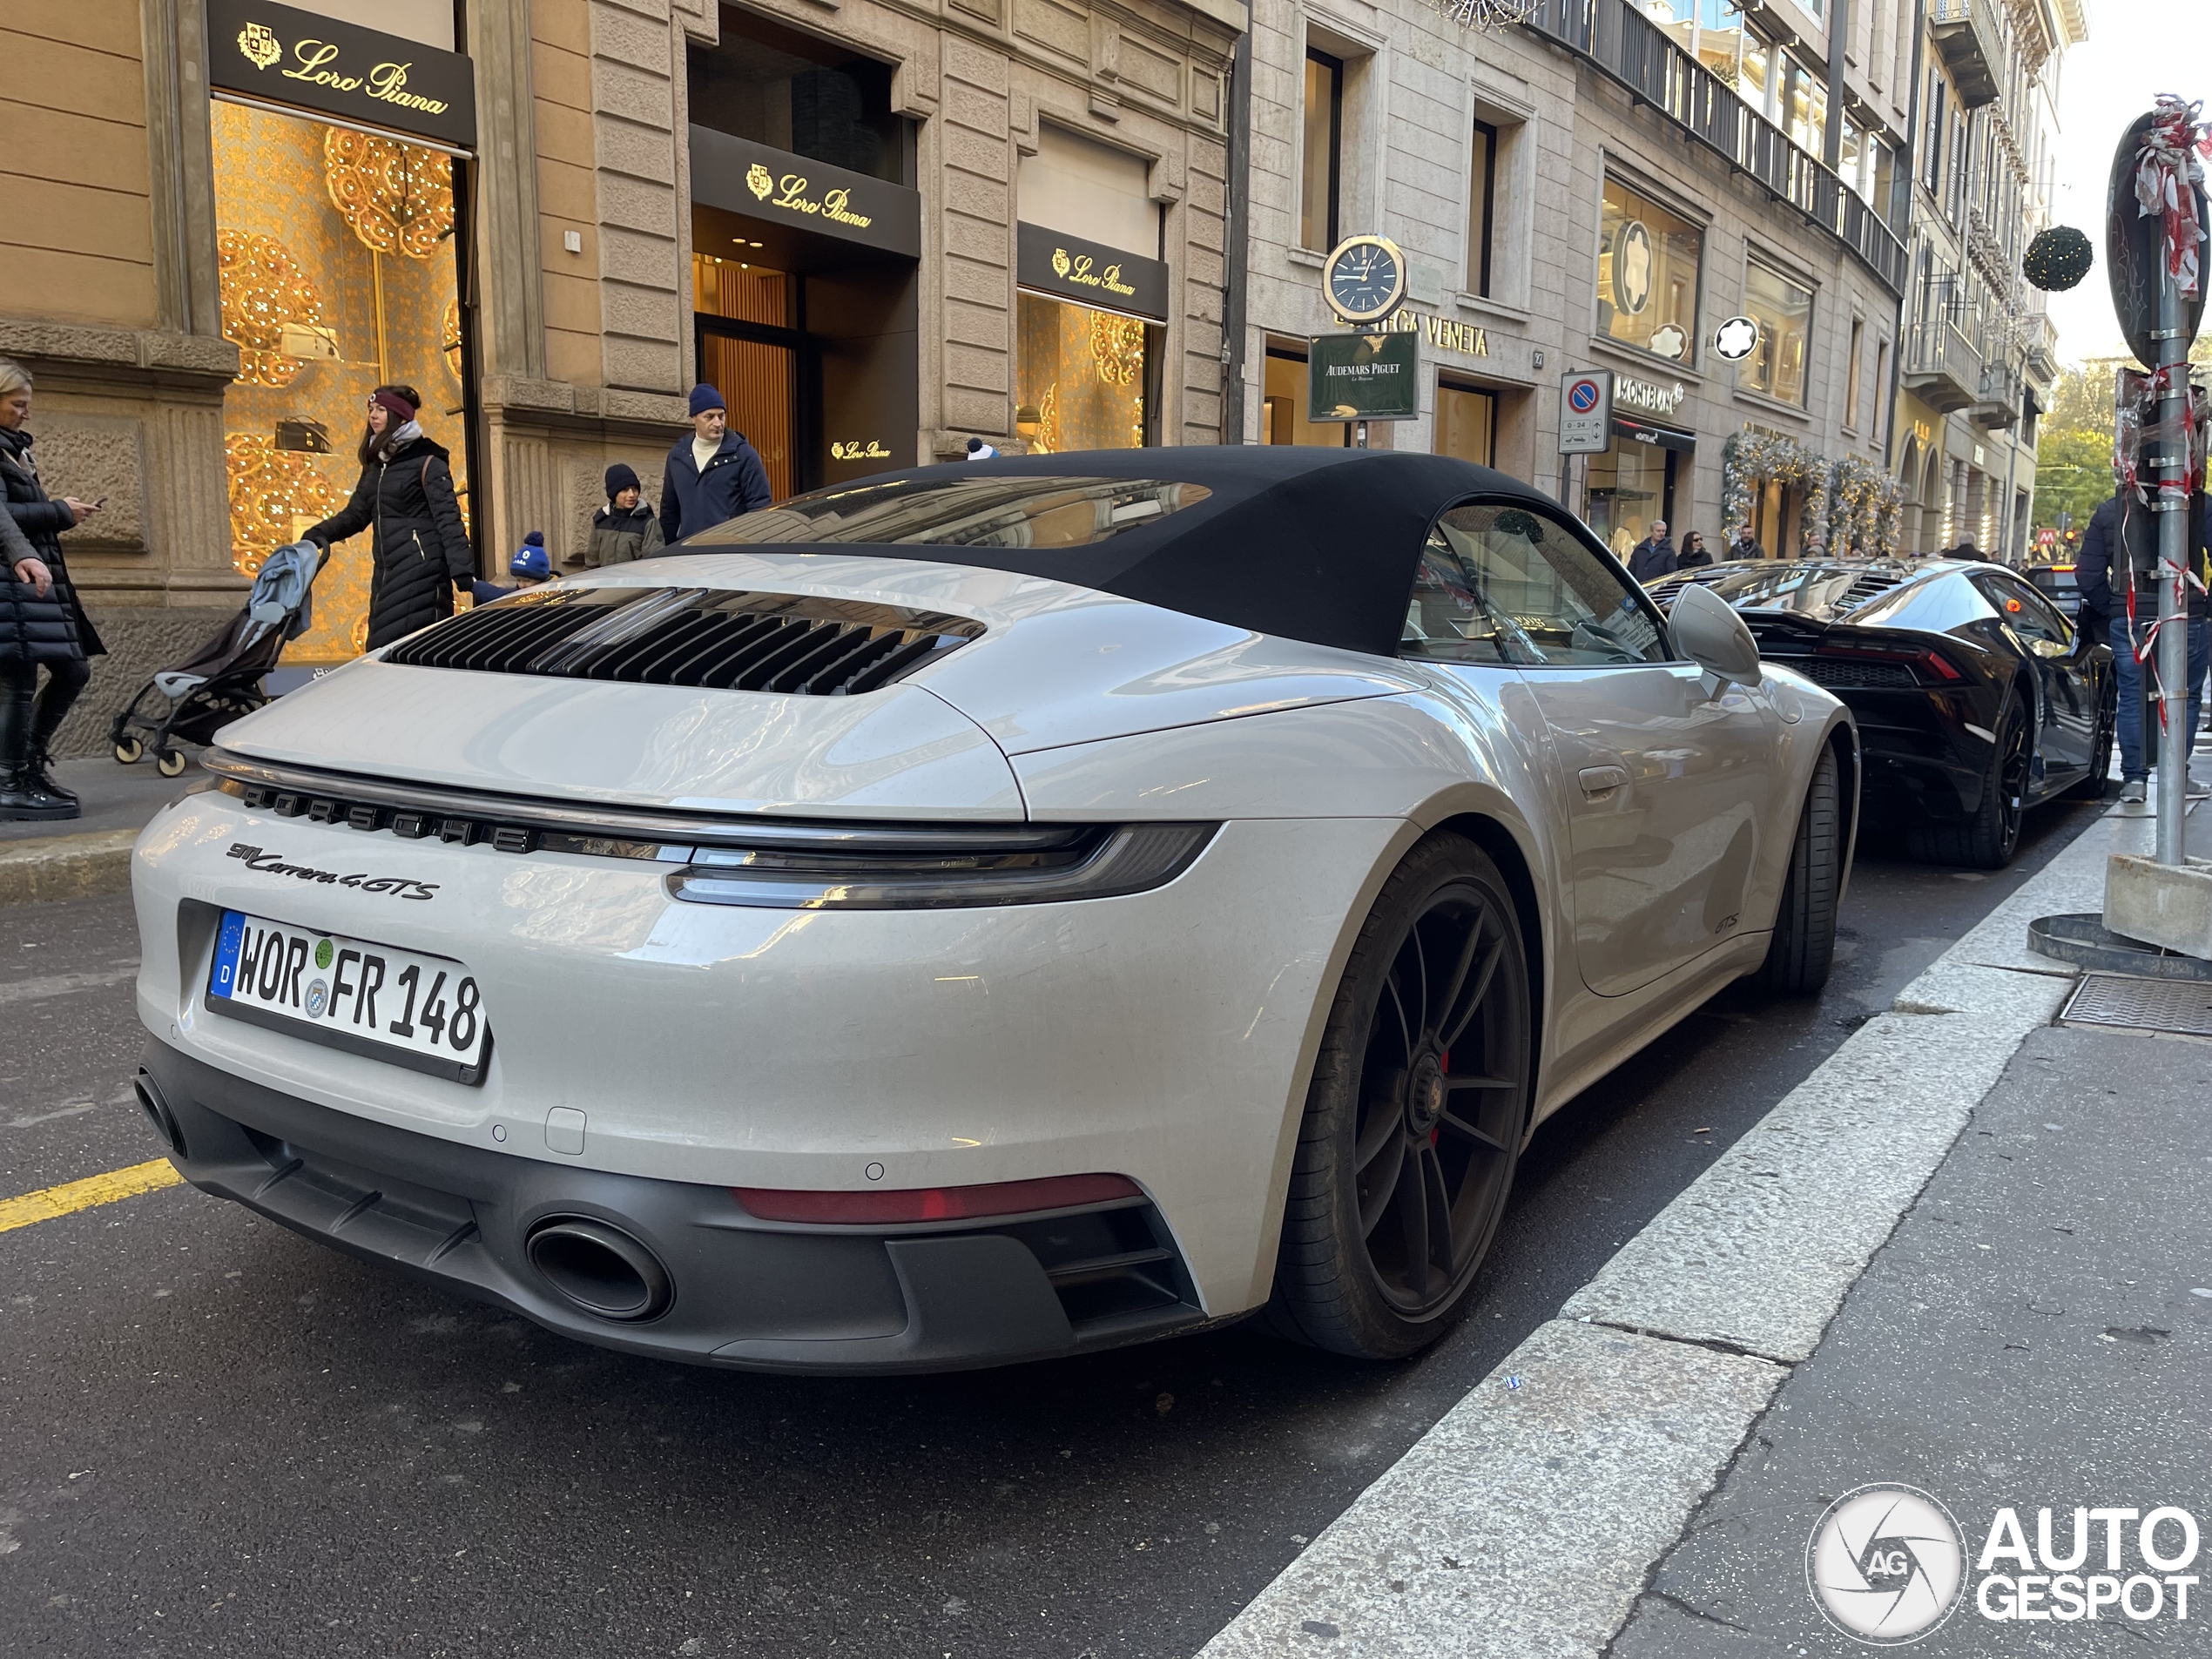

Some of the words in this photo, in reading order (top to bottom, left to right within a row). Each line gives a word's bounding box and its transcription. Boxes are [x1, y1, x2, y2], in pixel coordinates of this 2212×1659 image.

[282, 39, 363, 91] Loro
[365, 62, 448, 115] Piana
[772, 174, 821, 214] Loro
[821, 188, 872, 228] Piana
[1069, 255, 1102, 287] Loro
[1101, 264, 1136, 295] Piana
[1426, 315, 1489, 356] VENETA
[1325, 364, 1370, 376] AUDEMARS
[1372, 362, 1400, 374] PIGUET
[1616, 375, 1676, 415] MONTBLANC
[842, 441, 866, 459] Loro
[865, 439, 891, 457] Piana
[2040, 531, 2054, 542] M
[244, 788, 533, 853] PORSCHE
[226, 842, 261, 860] 911
[245, 854, 337, 884] Carrera
[338, 873, 368, 887] 4
[361, 877, 441, 900] GTS
[1715, 912, 1740, 934] GTS
[220, 965, 231, 984] D
[237, 927, 309, 1008] WOR
[327, 948, 386, 1028] FR
[389, 964, 480, 1051] 148
